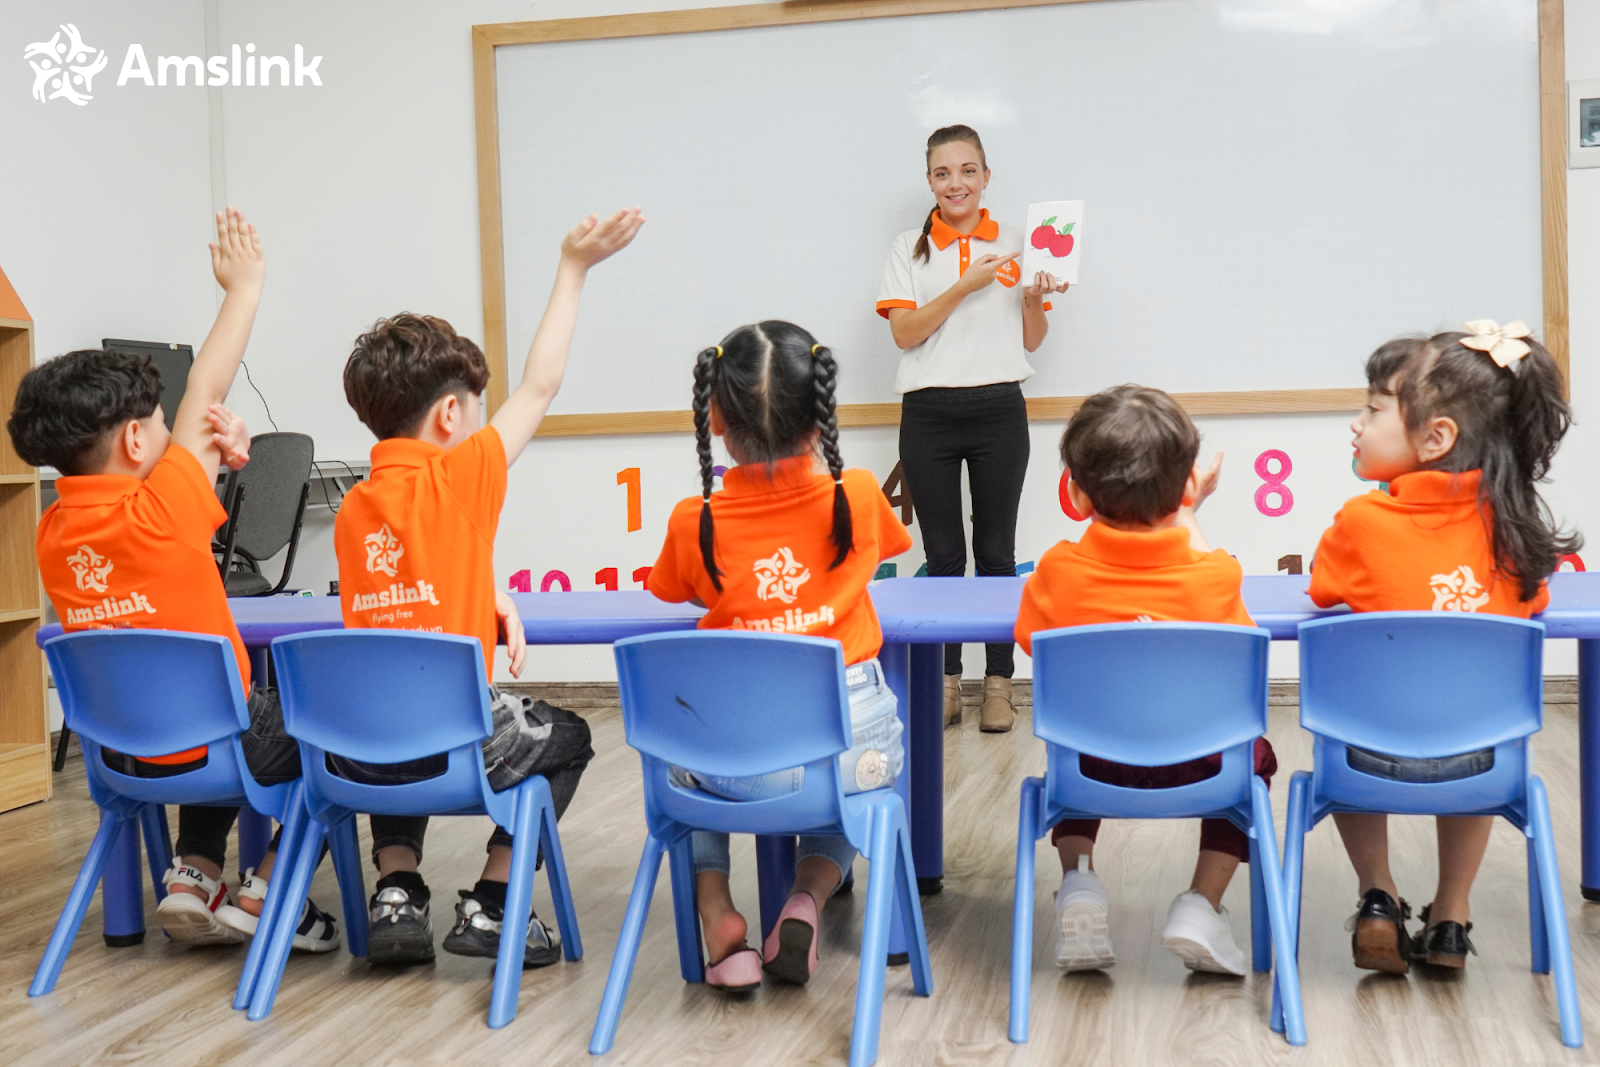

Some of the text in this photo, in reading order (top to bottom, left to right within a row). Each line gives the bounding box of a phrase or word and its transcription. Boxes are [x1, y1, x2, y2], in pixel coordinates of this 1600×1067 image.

[1253, 448, 1294, 518] 8
[616, 467, 642, 533] 1
[66, 591, 157, 625] Amslink
[352, 579, 440, 612] Amslink
[372, 609, 413, 624] flying free
[178, 867, 203, 882] FILA
